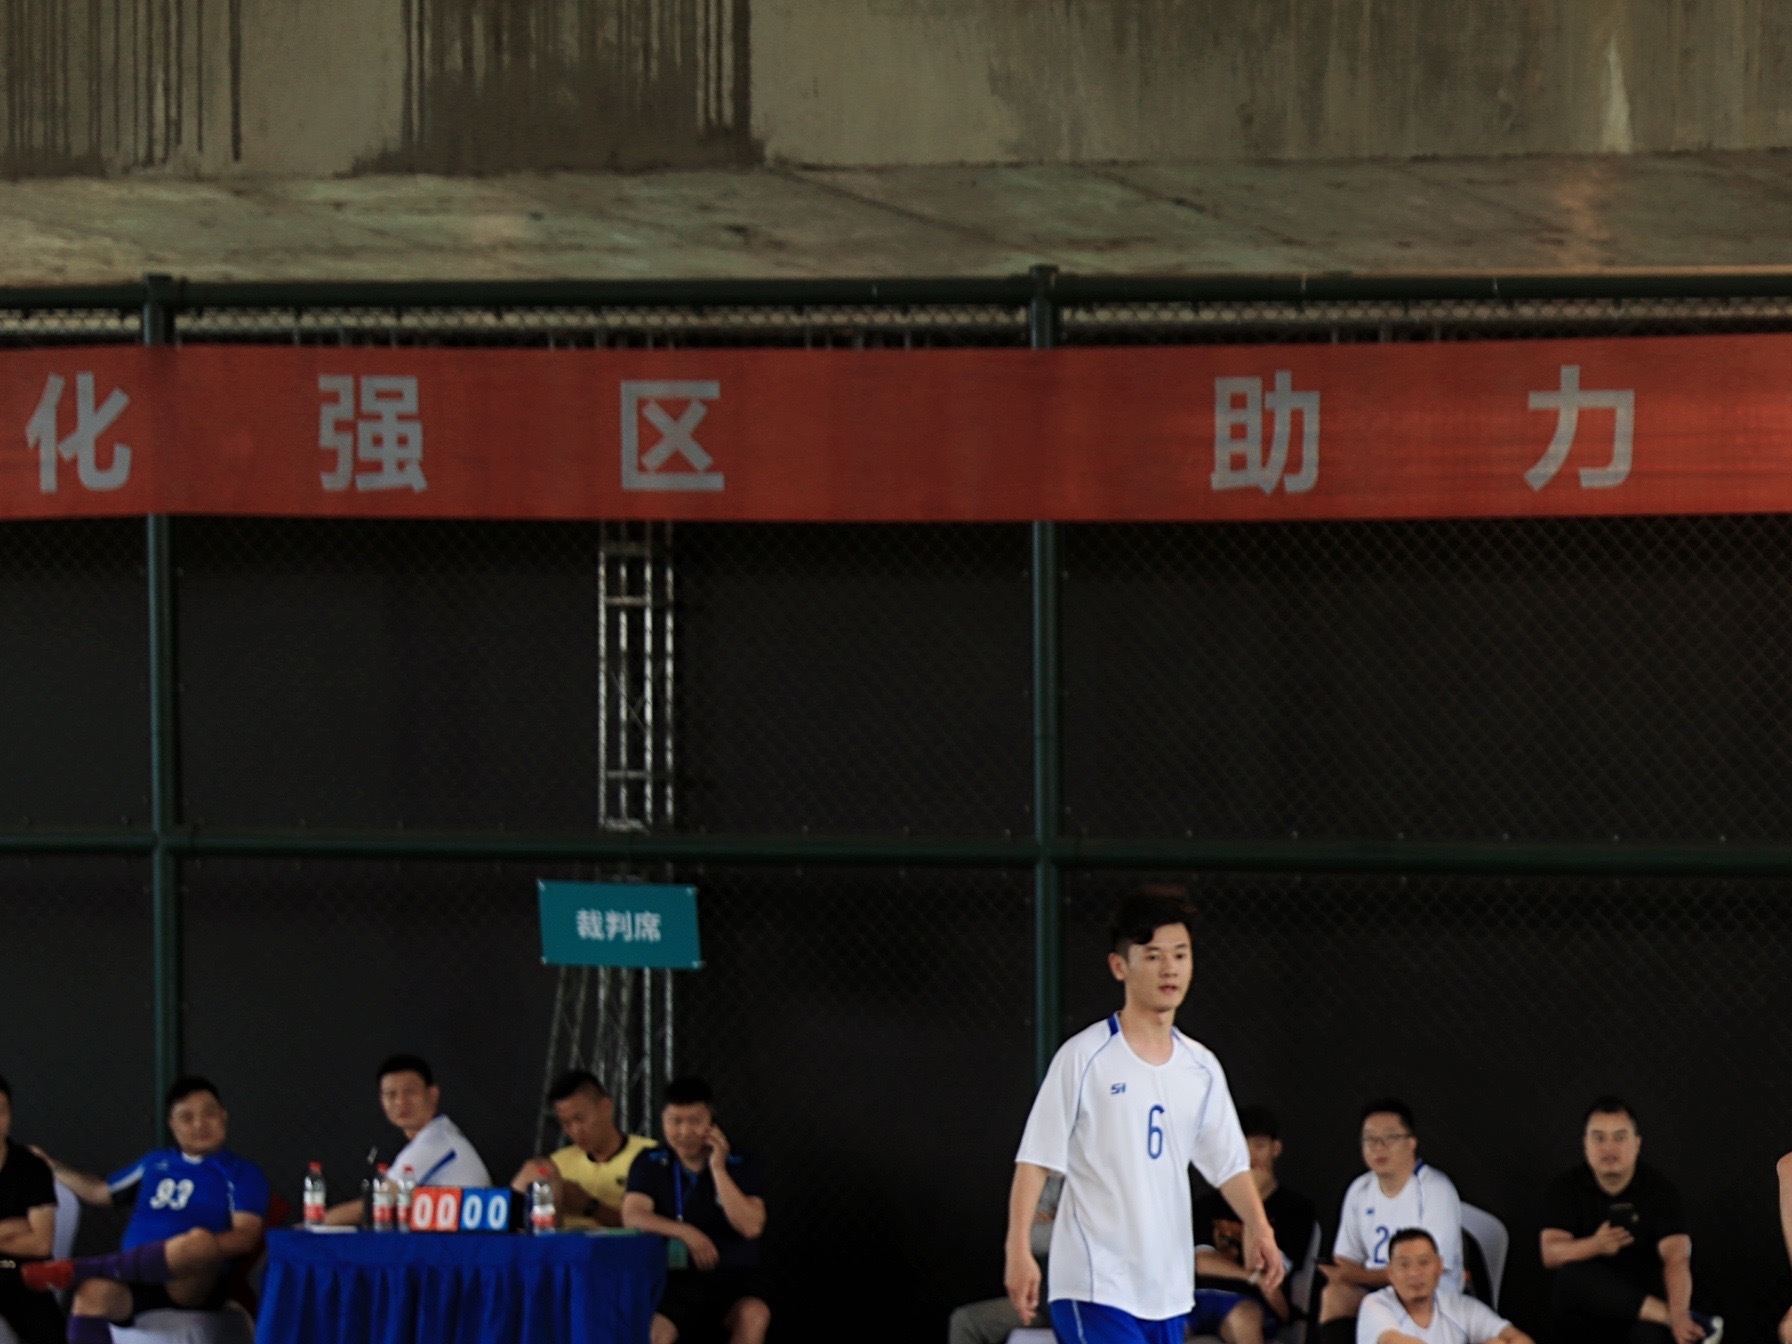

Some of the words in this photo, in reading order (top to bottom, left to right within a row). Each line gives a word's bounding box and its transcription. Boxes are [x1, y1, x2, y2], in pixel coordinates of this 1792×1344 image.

[575, 908, 662, 943] 裁判席
[1147, 1104, 1165, 1159] 6
